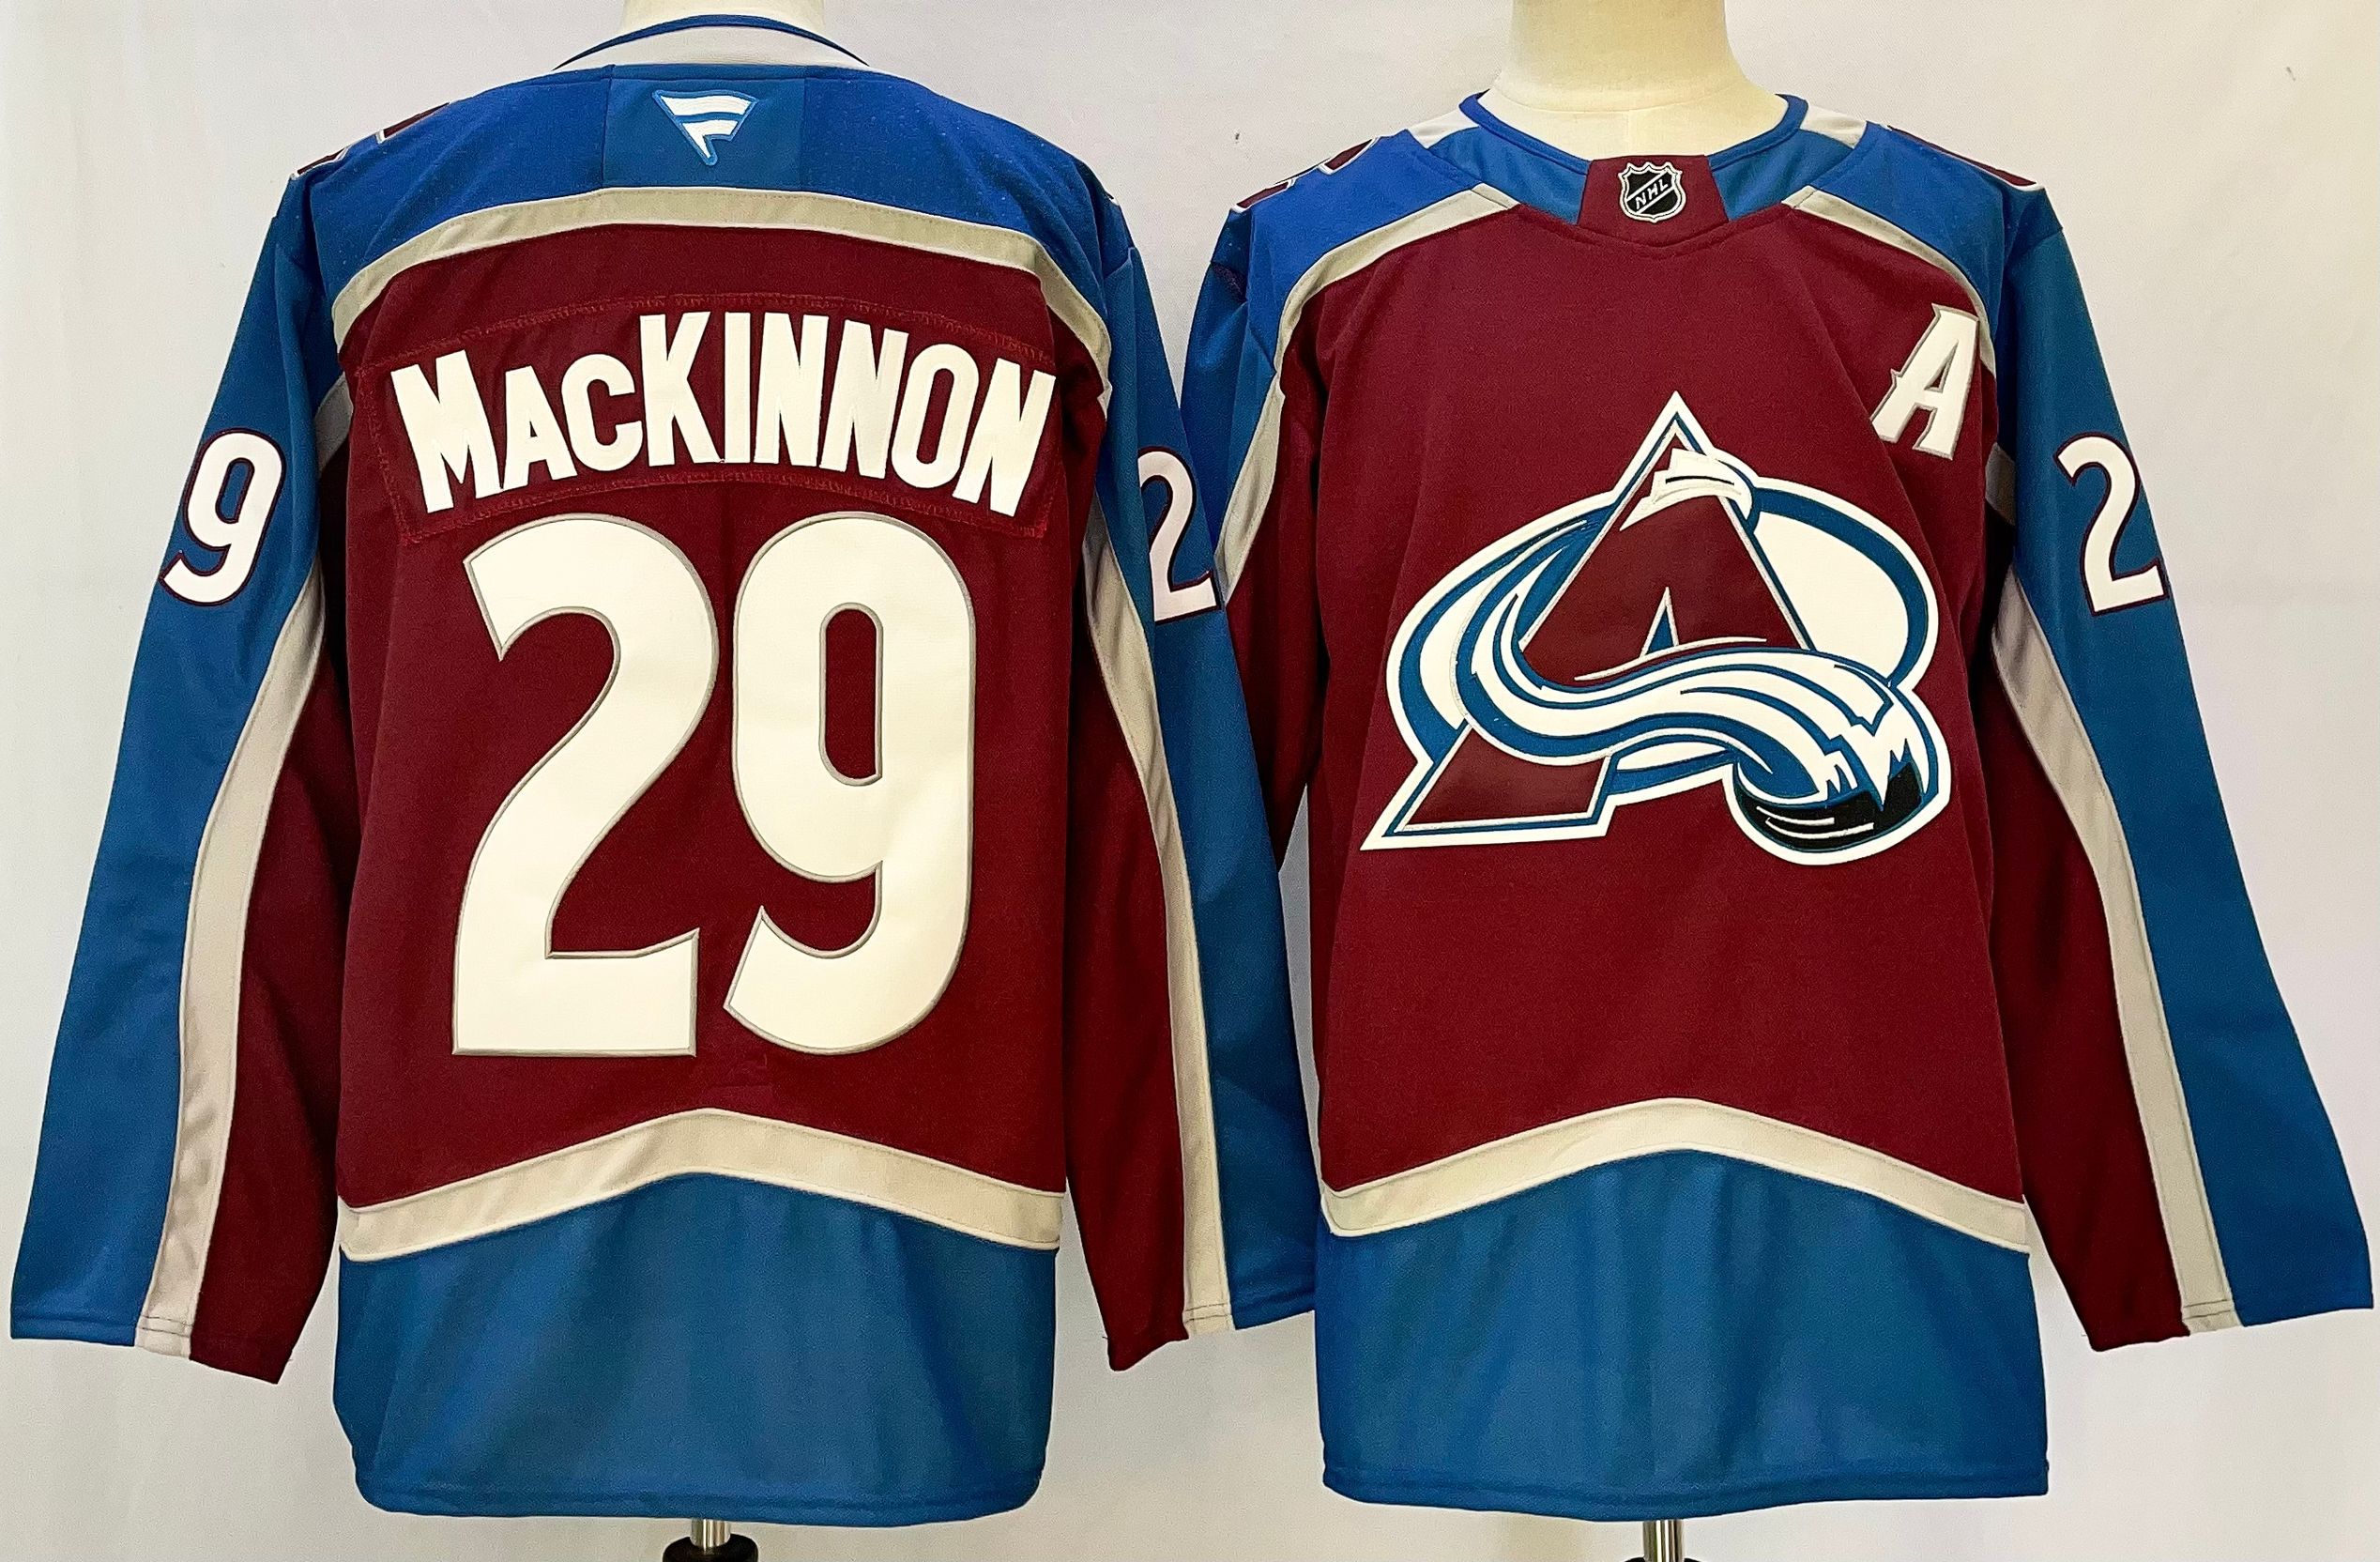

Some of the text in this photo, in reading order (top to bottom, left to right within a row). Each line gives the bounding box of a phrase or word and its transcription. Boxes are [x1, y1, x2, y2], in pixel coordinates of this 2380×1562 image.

[1635, 178, 1669, 210] NHL
[1871, 303, 1980, 460] A
[158, 427, 286, 606] 9
[1137, 446, 1218, 625] 2
[2053, 431, 2170, 617] 2
[451, 511, 976, 1057] 29
